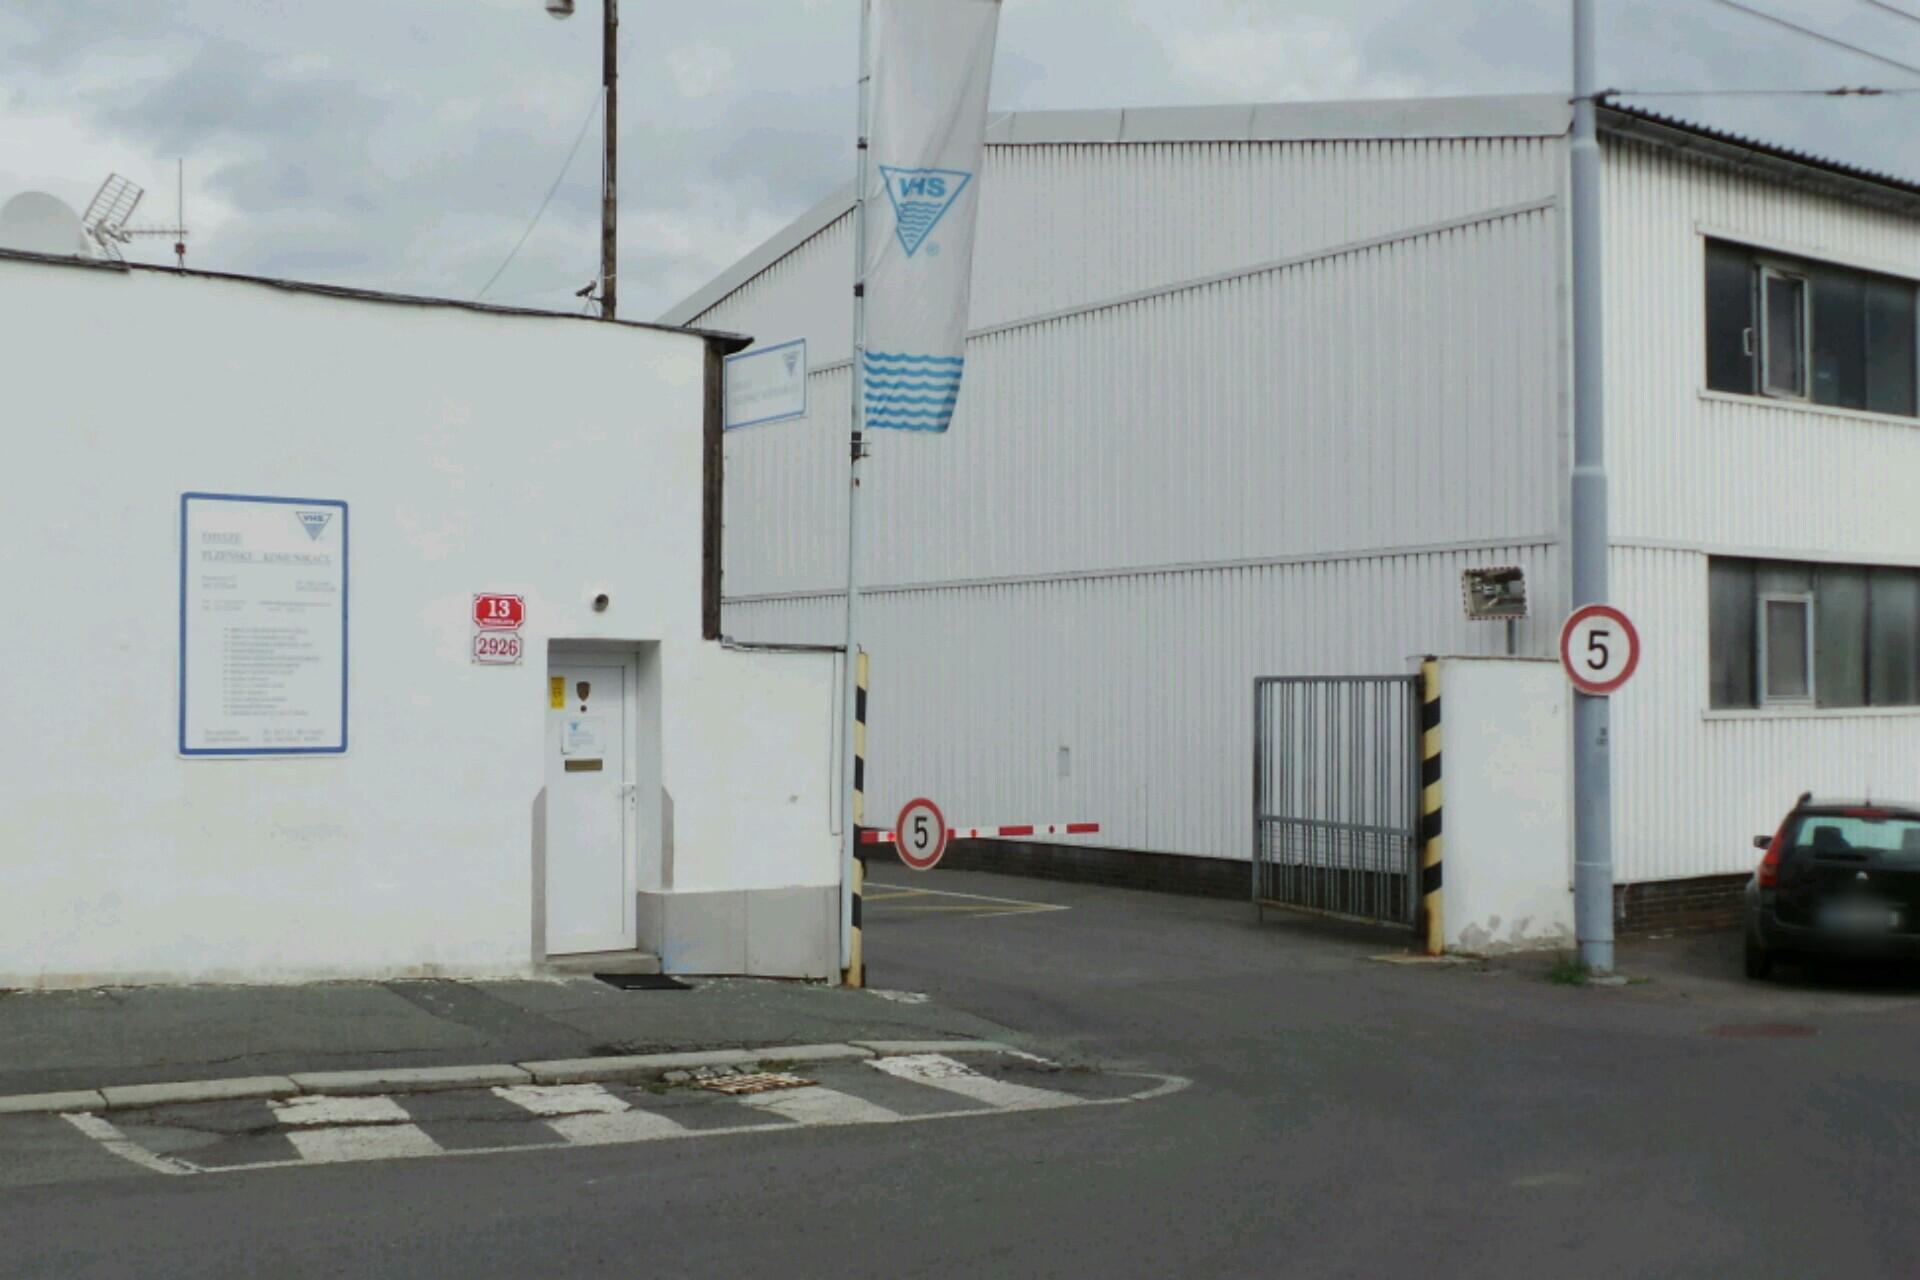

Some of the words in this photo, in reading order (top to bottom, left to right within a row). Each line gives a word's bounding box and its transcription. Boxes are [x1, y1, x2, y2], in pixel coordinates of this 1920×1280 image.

[899, 177, 945, 197] VHS
[488, 600, 511, 618] 13
[478, 637, 519, 656] 2926
[1587, 629, 1610, 671] 5
[914, 815, 928, 850] 5
